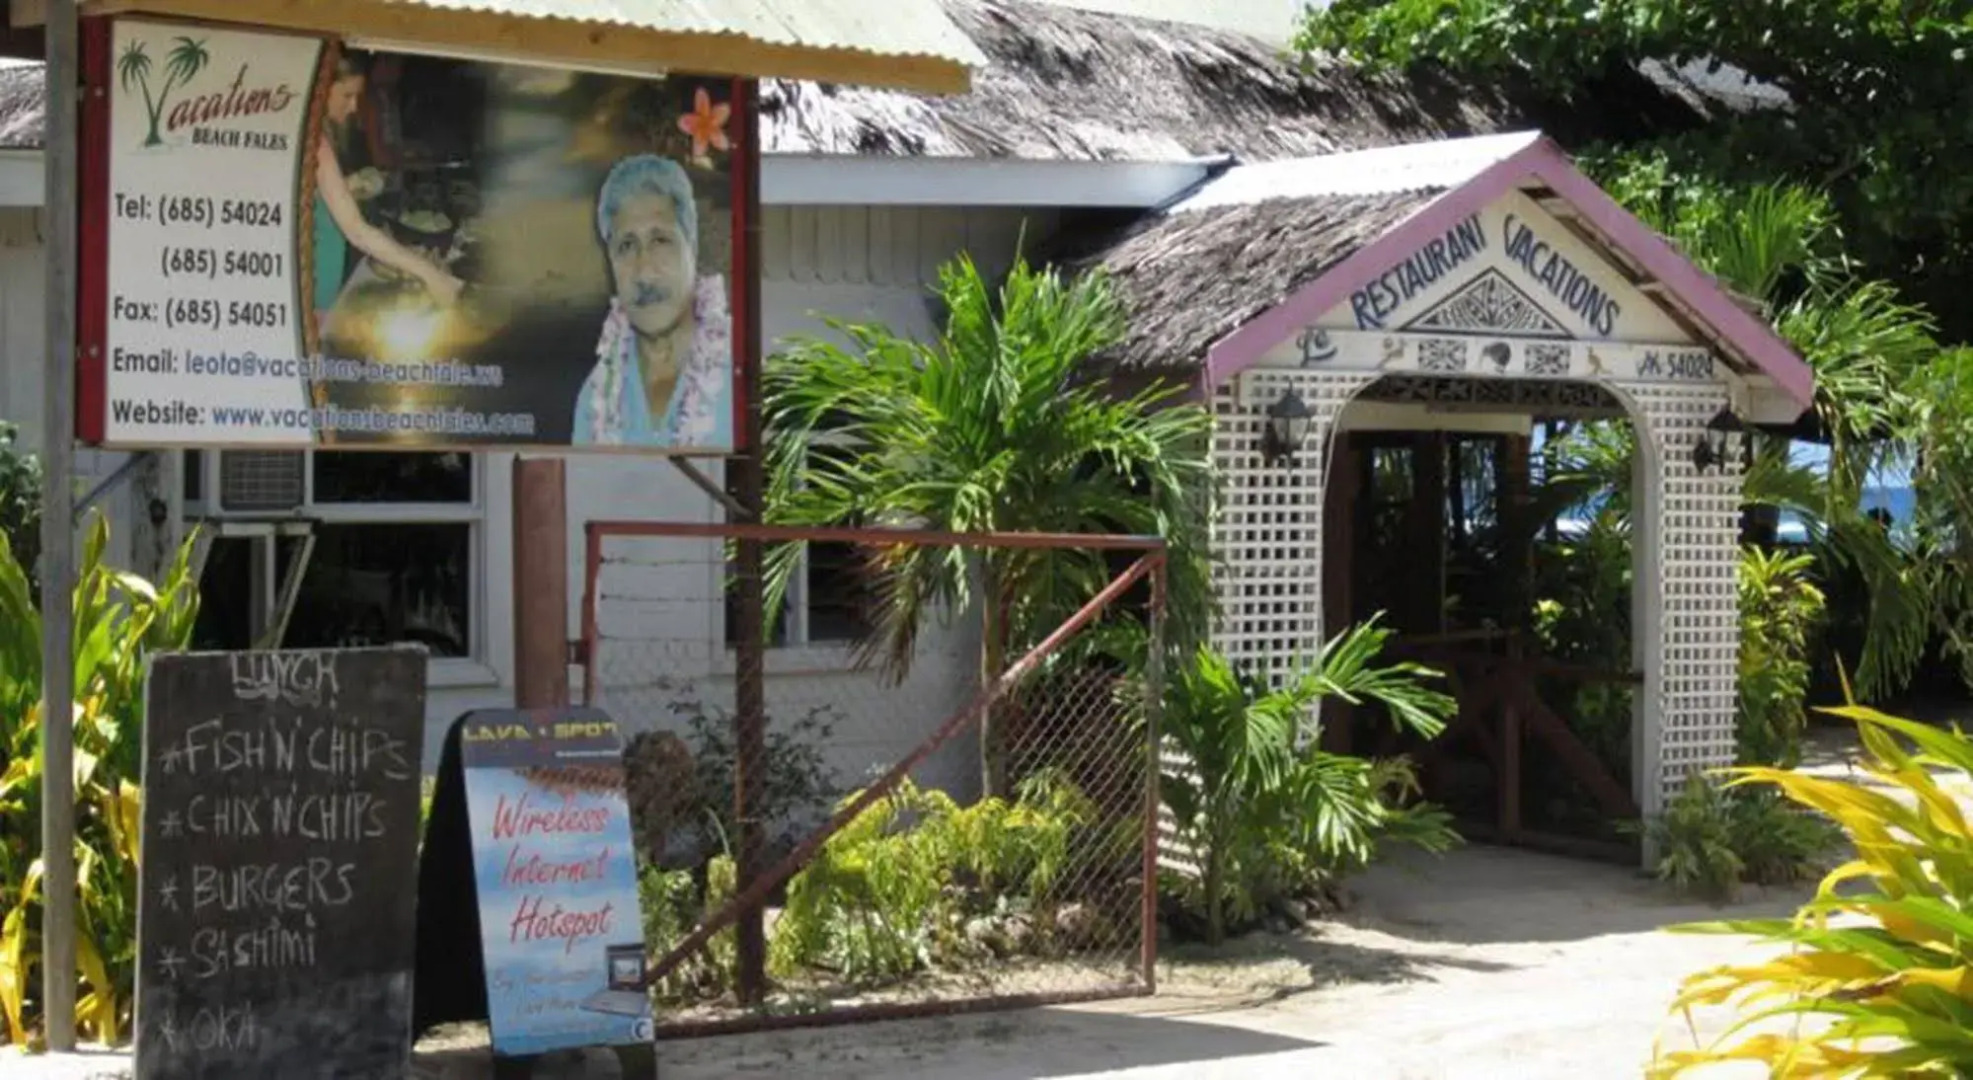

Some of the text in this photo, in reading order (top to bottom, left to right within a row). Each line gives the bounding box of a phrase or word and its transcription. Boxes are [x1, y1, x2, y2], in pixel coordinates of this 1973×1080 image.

[192, 127, 288, 150] BEACH FALES
[115, 193, 282, 228] Tel: (685) 54024
[161, 246, 283, 279] (685) 54001
[1351, 213, 1620, 337] RESTAURANT VACATIONS
[113, 297, 286, 329] Fax: (685) 54051
[113, 348, 179, 374] Email:
[1667, 354, 1713, 378] 54024
[112, 400, 205, 426] Website:
[231, 652, 340, 694] LUNCH
[462, 722, 618, 742] LAVA SPOT
[492, 792, 610, 841] Wireless
[502, 845, 610, 885] Internet
[193, 857, 356, 912] BURGERS
[510, 894, 613, 955] Hotspot
